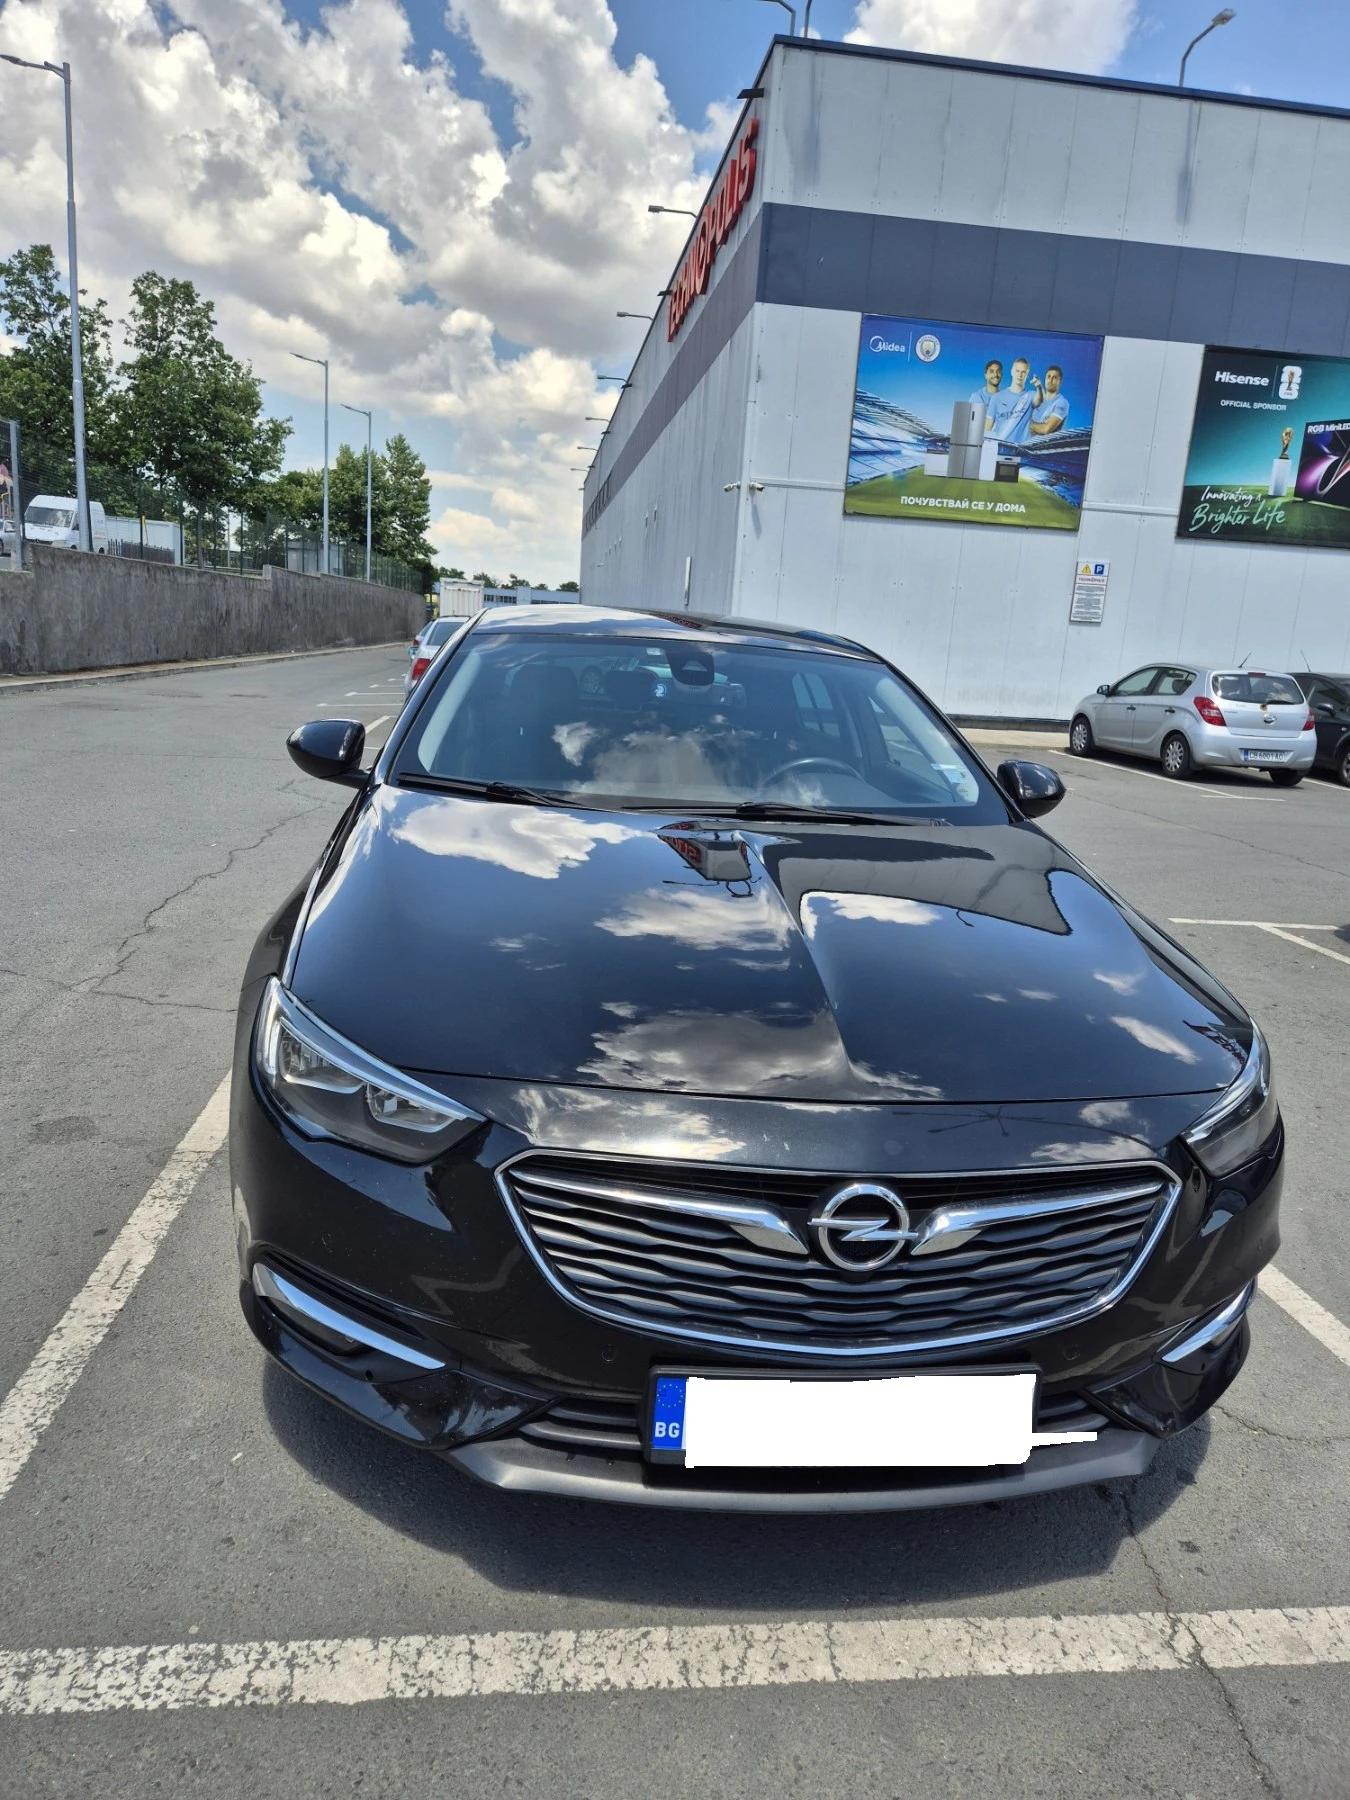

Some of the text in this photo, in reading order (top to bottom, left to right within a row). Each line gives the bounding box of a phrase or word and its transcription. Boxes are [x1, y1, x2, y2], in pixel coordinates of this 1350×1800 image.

[667, 118, 759, 342] TECHNOPOLIS
[870, 335, 906, 353] Midea
[1214, 370, 1270, 387] Hisense
[1220, 399, 1287, 411] OFFICIAL SPONSOR
[1307, 424, 1325, 434] RGB
[900, 495, 1026, 513] ПОЧУВСТВАЙ СЕ У ДОМА
[1201, 485, 1254, 508] Innovating
[1189, 499, 1286, 534] Brighter Life
[654, 1421, 681, 1439] BG
